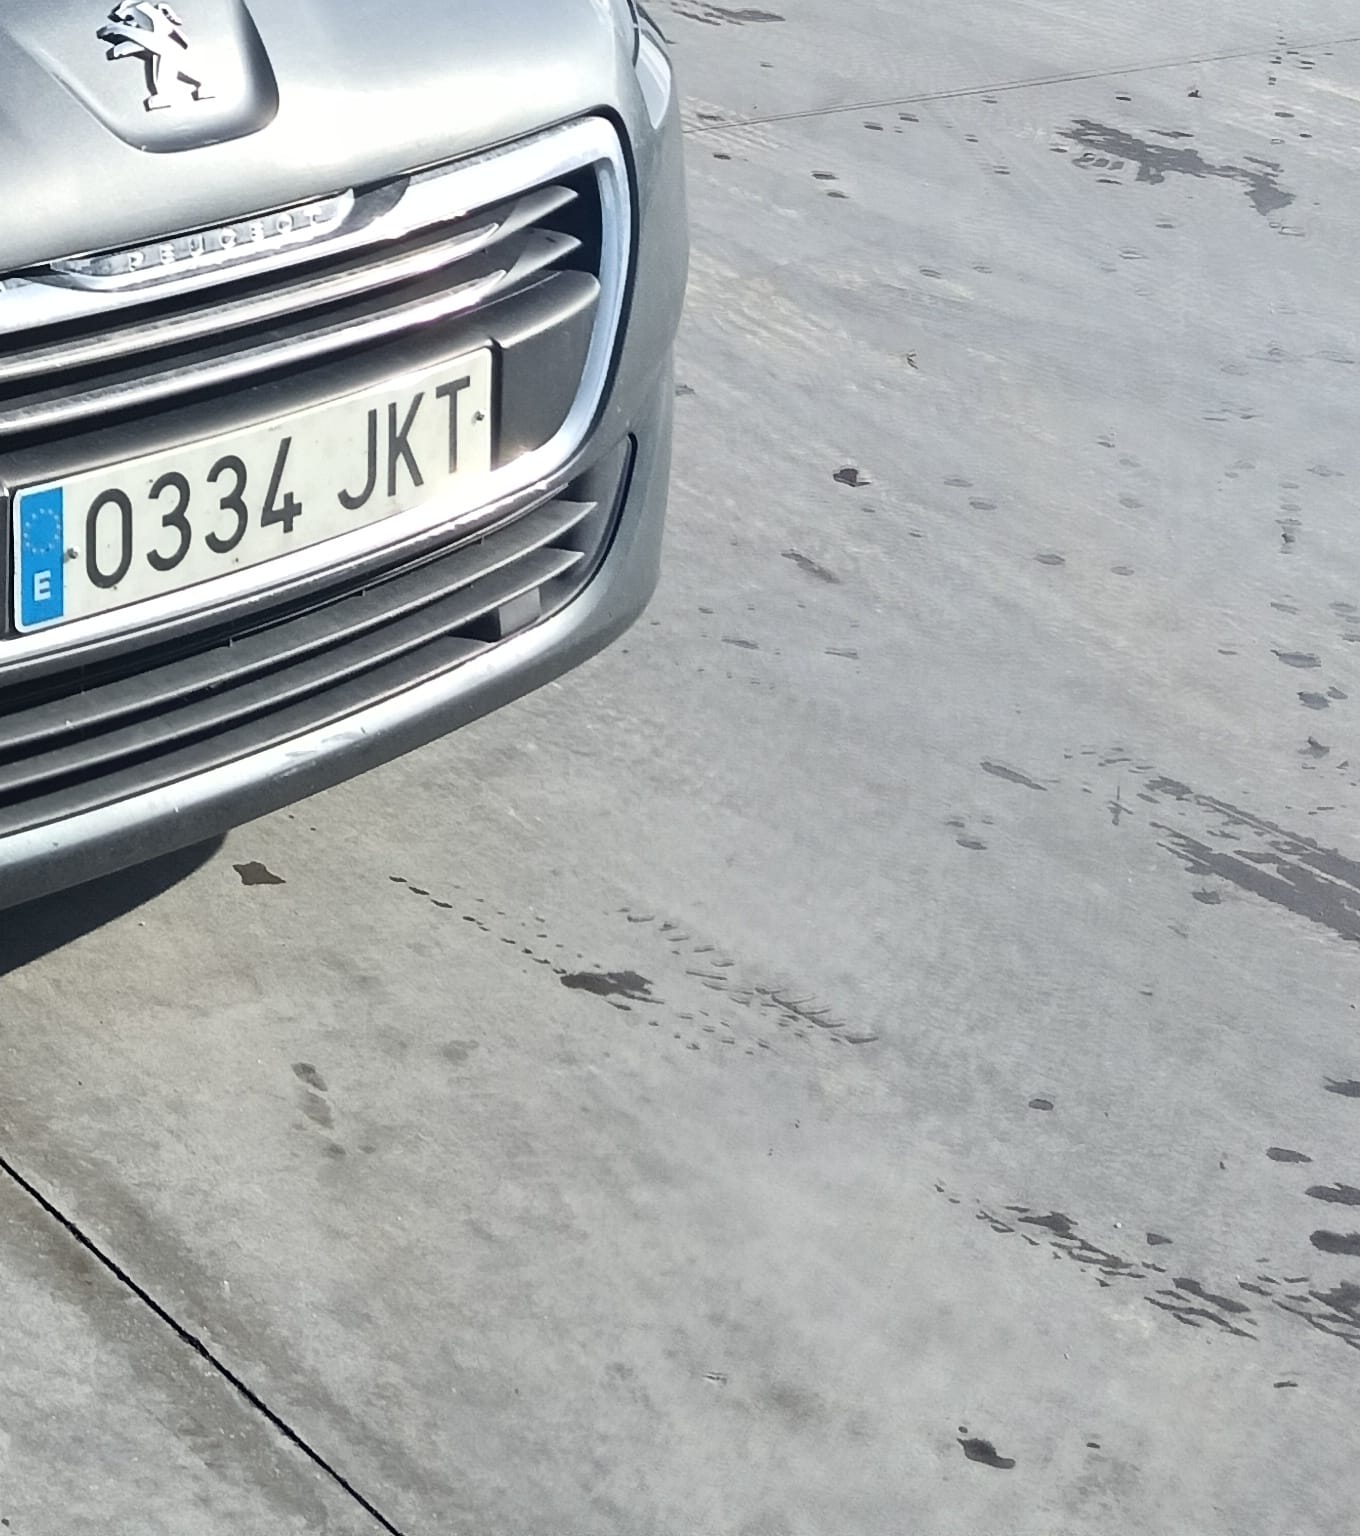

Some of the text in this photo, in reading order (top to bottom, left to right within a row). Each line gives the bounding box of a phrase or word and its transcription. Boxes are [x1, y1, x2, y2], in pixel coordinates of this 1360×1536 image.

[126, 205, 322, 271] PEUGEOT
[84, 374, 473, 590] 0334 JKT
[33, 570, 51, 602] E
